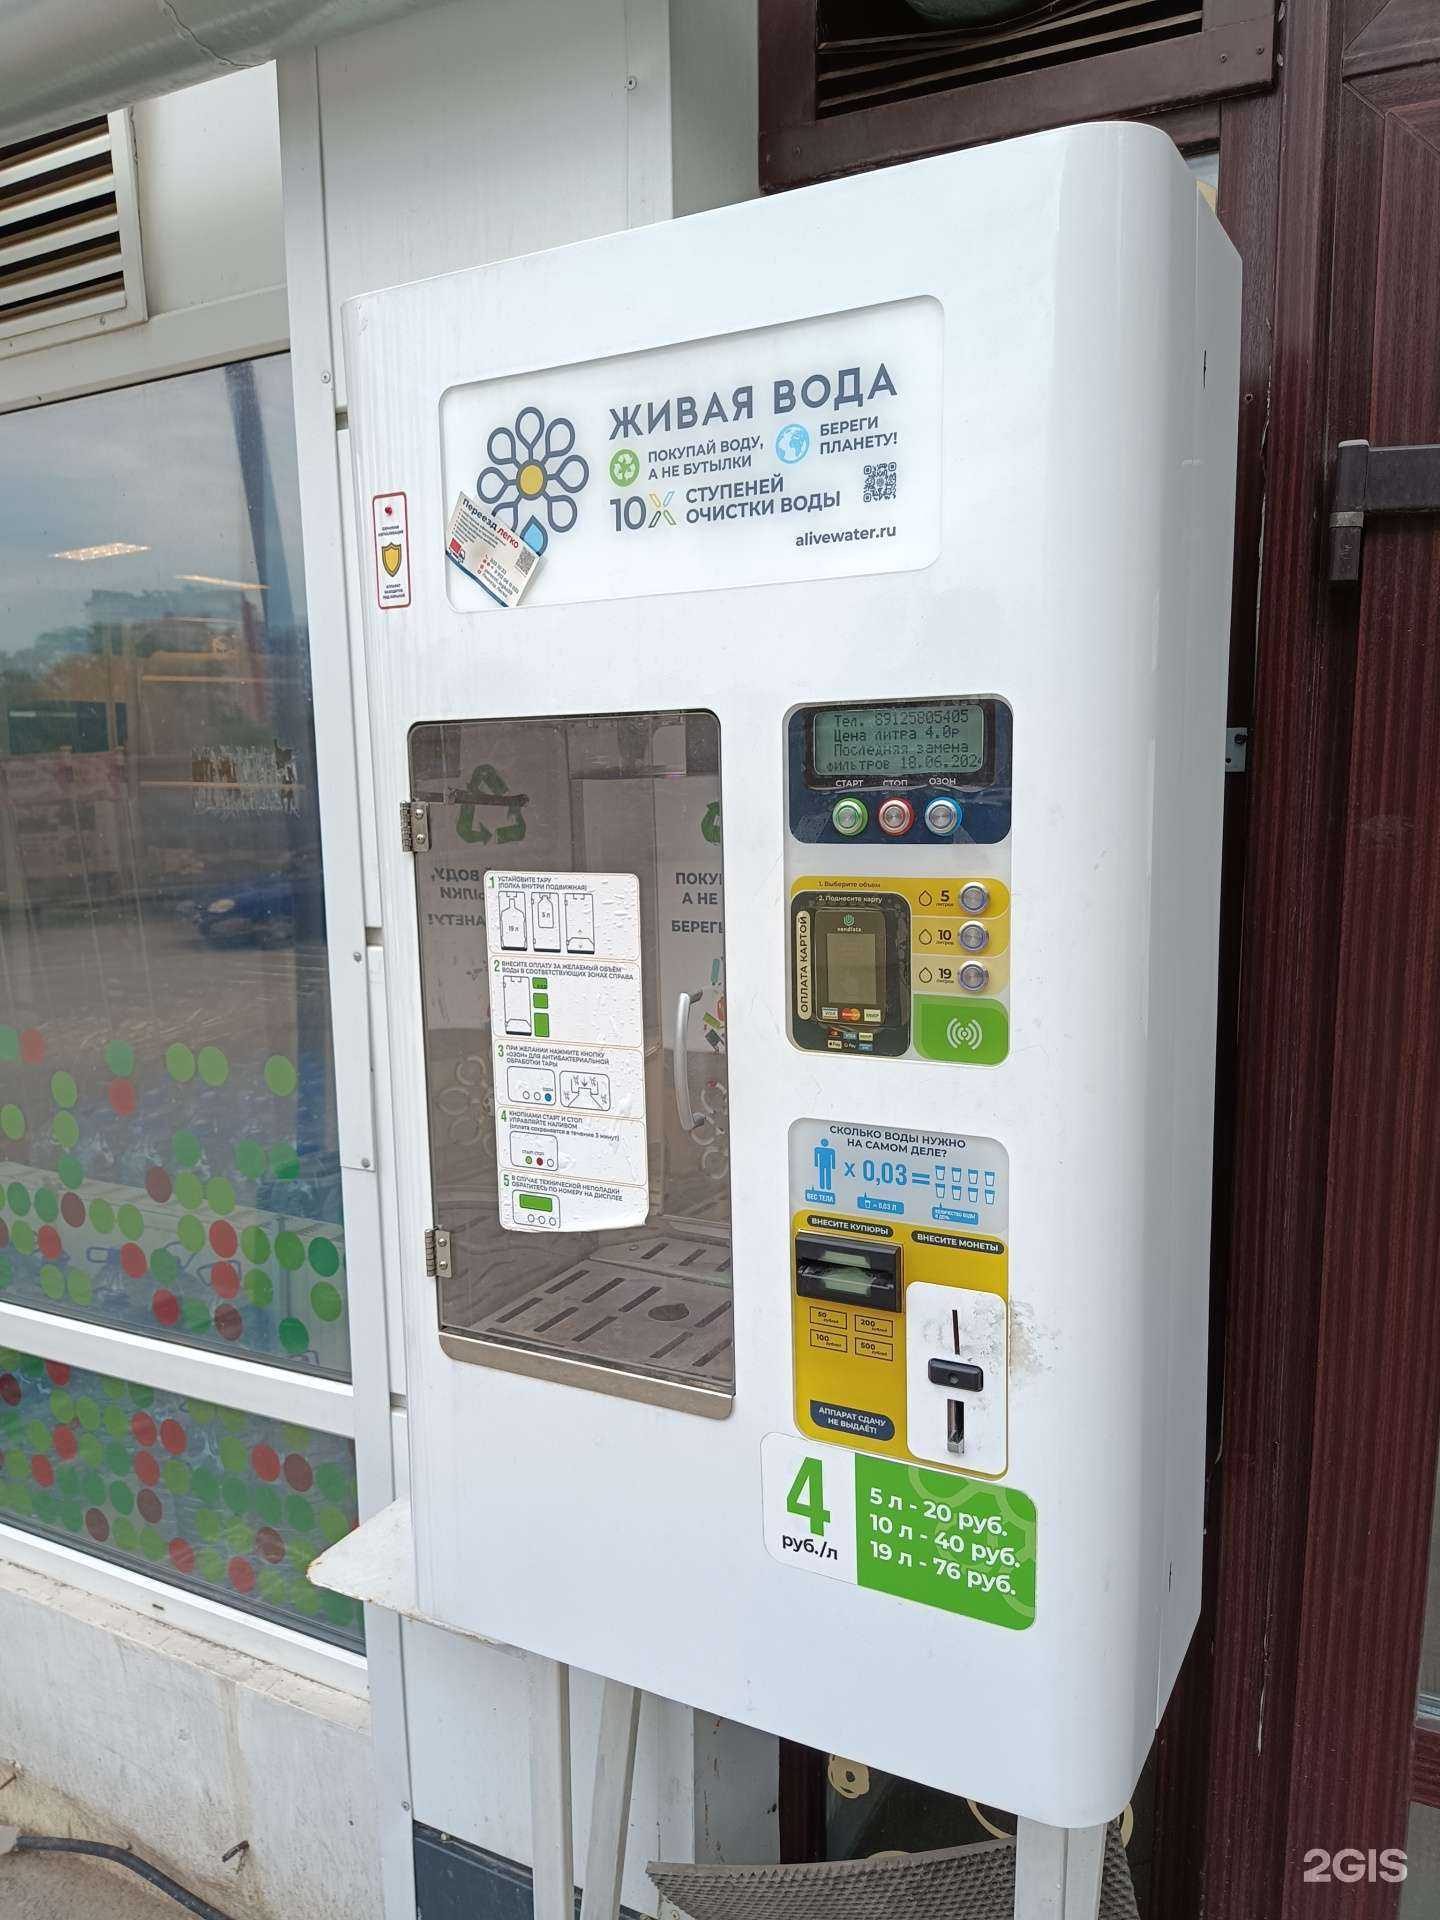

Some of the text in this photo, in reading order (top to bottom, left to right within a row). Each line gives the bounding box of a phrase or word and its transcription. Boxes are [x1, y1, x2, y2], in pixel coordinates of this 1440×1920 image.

[609, 363, 897, 440] ЖИВАЯ ВОДА
[820, 416, 878, 436] БЕРЕГИ
[649, 436, 764, 461] ПОКУПАЙ ВОДУ,
[820, 432, 898, 455] ПЛАНЕТУ!
[648, 456, 752, 480] А НЕ БУТЫЛКИ
[686, 474, 784, 503] СТУПЕНЕЙ
[686, 491, 840, 523] ОЧИСТКИ ВОДЫ
[462, 498, 498, 531] Переезд
[497, 527, 520, 549] легко
[796, 525, 897, 547] alivewater.ru
[834, 709, 968, 728] Тел. 89125805405
[834, 729, 867, 743] Цена
[875, 727, 917, 741] литра
[834, 741, 969, 757] Последняя замена
[835, 779, 864, 787] СТАРТ
[882, 779, 908, 787] СТОП
[928, 777, 956, 786] ОЗОН
[489, 876, 494, 889] 1
[675, 871, 722, 886] ПОКУ
[824, 881, 857, 889] Выберите
[682, 892, 718, 905] А НЕ
[940, 890, 950, 902] 5
[938, 930, 952, 941] 10
[494, 960, 500, 972] 2
[562, 964, 598, 972] ЖЕЛАЕМЫЙ
[525, 968, 586, 978] СООТВЕТСТВУЮЩИХ
[798, 916, 809, 1013] ОПЛАТА КАРТОЙ
[938, 968, 952, 979] 19
[498, 1045, 504, 1057] 3
[549, 1048, 580, 1056] НАЖМИТЕ
[580, 1050, 605, 1058] КНОПКУ
[542, 1055, 609, 1065] АНТИБАКТЕРИАЛЬНОЙ
[506, 1057, 541, 1066] ОБРАБОТКИ
[501, 1110, 507, 1122] 4
[509, 1111, 541, 1119] КНОПКАМИ
[547, 1121, 578, 1129] НАЛИВОМ
[830, 1125, 966, 1149] СКОЛЬКО ВОДЫ НУЖНО
[847, 1138, 947, 1158] НА САМОМ ДЕЛЕ?
[862, 1160, 907, 1186] 0,03
[503, 1174, 509, 1187] 5
[540, 1178, 582, 1190] ТЕХНИЧЕСКОЙ
[582, 1184, 620, 1195] НЕПОЛАДКИ
[511, 1181, 548, 1192] ОБРАТИТЕСЬ
[559, 1187, 583, 1196] НОМЕРУ
[594, 1192, 623, 1202] ДИСПЛЕЕ
[811, 1218, 889, 1235] ВНЕСИТЕ КУПЮРЫ
[917, 1233, 999, 1252] ВНЕСИТЕ МОНЕТЫ
[860, 1319, 876, 1327] 200
[816, 1334, 829, 1342] 100
[860, 1342, 876, 1350] 500
[818, 1406, 886, 1427] АППАРАТ СДАЧУ
[827, 1417, 877, 1434] НЕ ВЫДАЁТ!
[786, 1456, 831, 1537] 4
[870, 1487, 882, 1505] 5
[888, 1496, 903, 1510] л
[923, 1501, 951, 1522] 20
[958, 1511, 1008, 1536] руб.
[782, 1534, 838, 1560] руб./л
[870, 1514, 893, 1534] 10
[898, 1526, 913, 1540] л
[934, 1532, 964, 1553] 40
[971, 1543, 1021, 1568] руб.
[870, 1541, 892, 1561] 19
[898, 1553, 912, 1567] л
[933, 1558, 961, 1580] 76
[967, 1569, 1016, 1596] руб.
